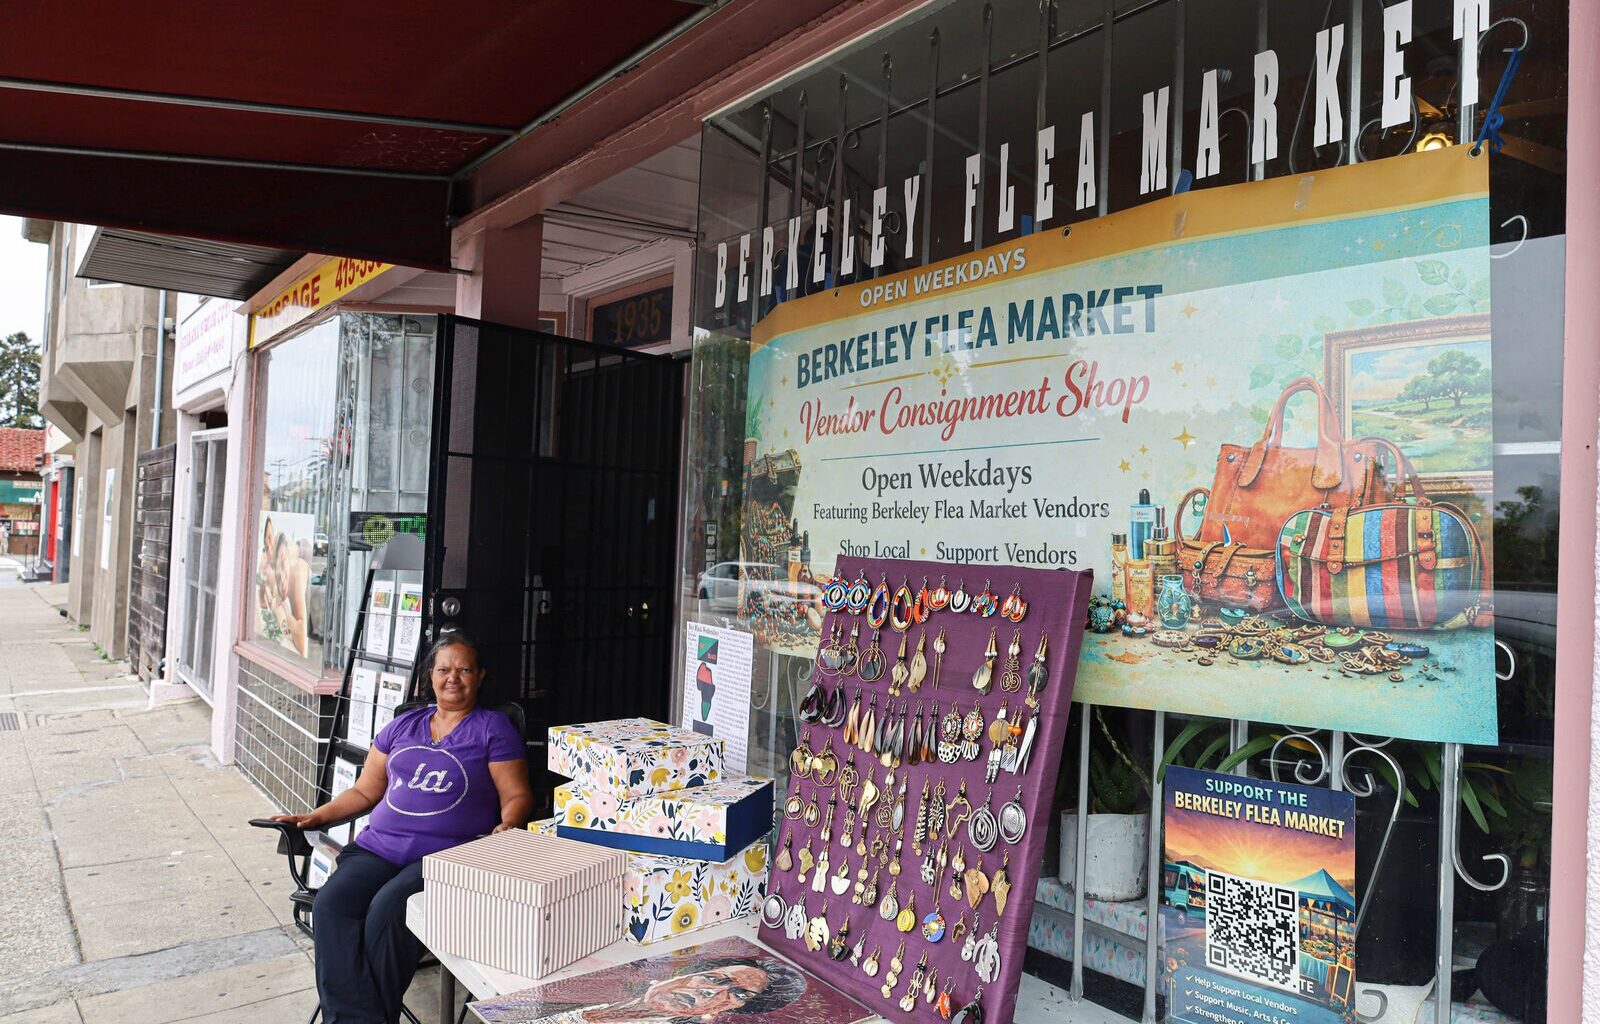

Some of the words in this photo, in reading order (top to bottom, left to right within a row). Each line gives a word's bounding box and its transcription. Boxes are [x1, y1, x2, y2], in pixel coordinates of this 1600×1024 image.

[715, 175, 920, 308] BERKELEY
[963, 111, 1096, 243] FLEA
[1139, 0, 1490, 195] MARKET
[261, 274, 321, 319] SAGE
[860, 278, 909, 308] OPEN
[913, 247, 1027, 296] WEEKDAYS
[797, 320, 918, 389] BERKELEY
[925, 306, 998, 357] FLEA
[1007, 284, 1163, 344] MARKET
[799, 396, 875, 445] Vendor
[879, 376, 1051, 442] Consignment
[1055, 359, 1151, 424] Shop
[862, 466, 912, 497] Open
[918, 457, 1033, 494] Weekdays
[813, 502, 868, 524] Featuring
[871, 499, 930, 524] Berkeley
[934, 498, 964, 519] Flea
[969, 499, 1028, 520] Market
[1033, 495, 1110, 519] Vendors
[839, 538, 871, 558] Shop
[874, 539, 911, 559] Local
[936, 541, 1000, 565] Support
[1004, 542, 1078, 565] Vendors
[1205, 778, 1274, 802] SUPPORT
[1278, 789, 1308, 808] THE
[1174, 790, 1242, 820] BERKELEY
[1245, 803, 1281, 827] FLEA
[1284, 809, 1345, 840] MARKET
[1194, 975, 1211, 989] Help
[1212, 982, 1241, 998] Support
[1242, 990, 1262, 1004] Local
[1264, 997, 1298, 1015] Vendors
[1194, 990, 1225, 1008] Support
[1226, 1000, 1252, 1017] Music,
[1253, 1010, 1271, 1023] Arts
[1272, 1015, 1279, 1024] &
[1194, 1005, 1236, 1024] Strengthen
